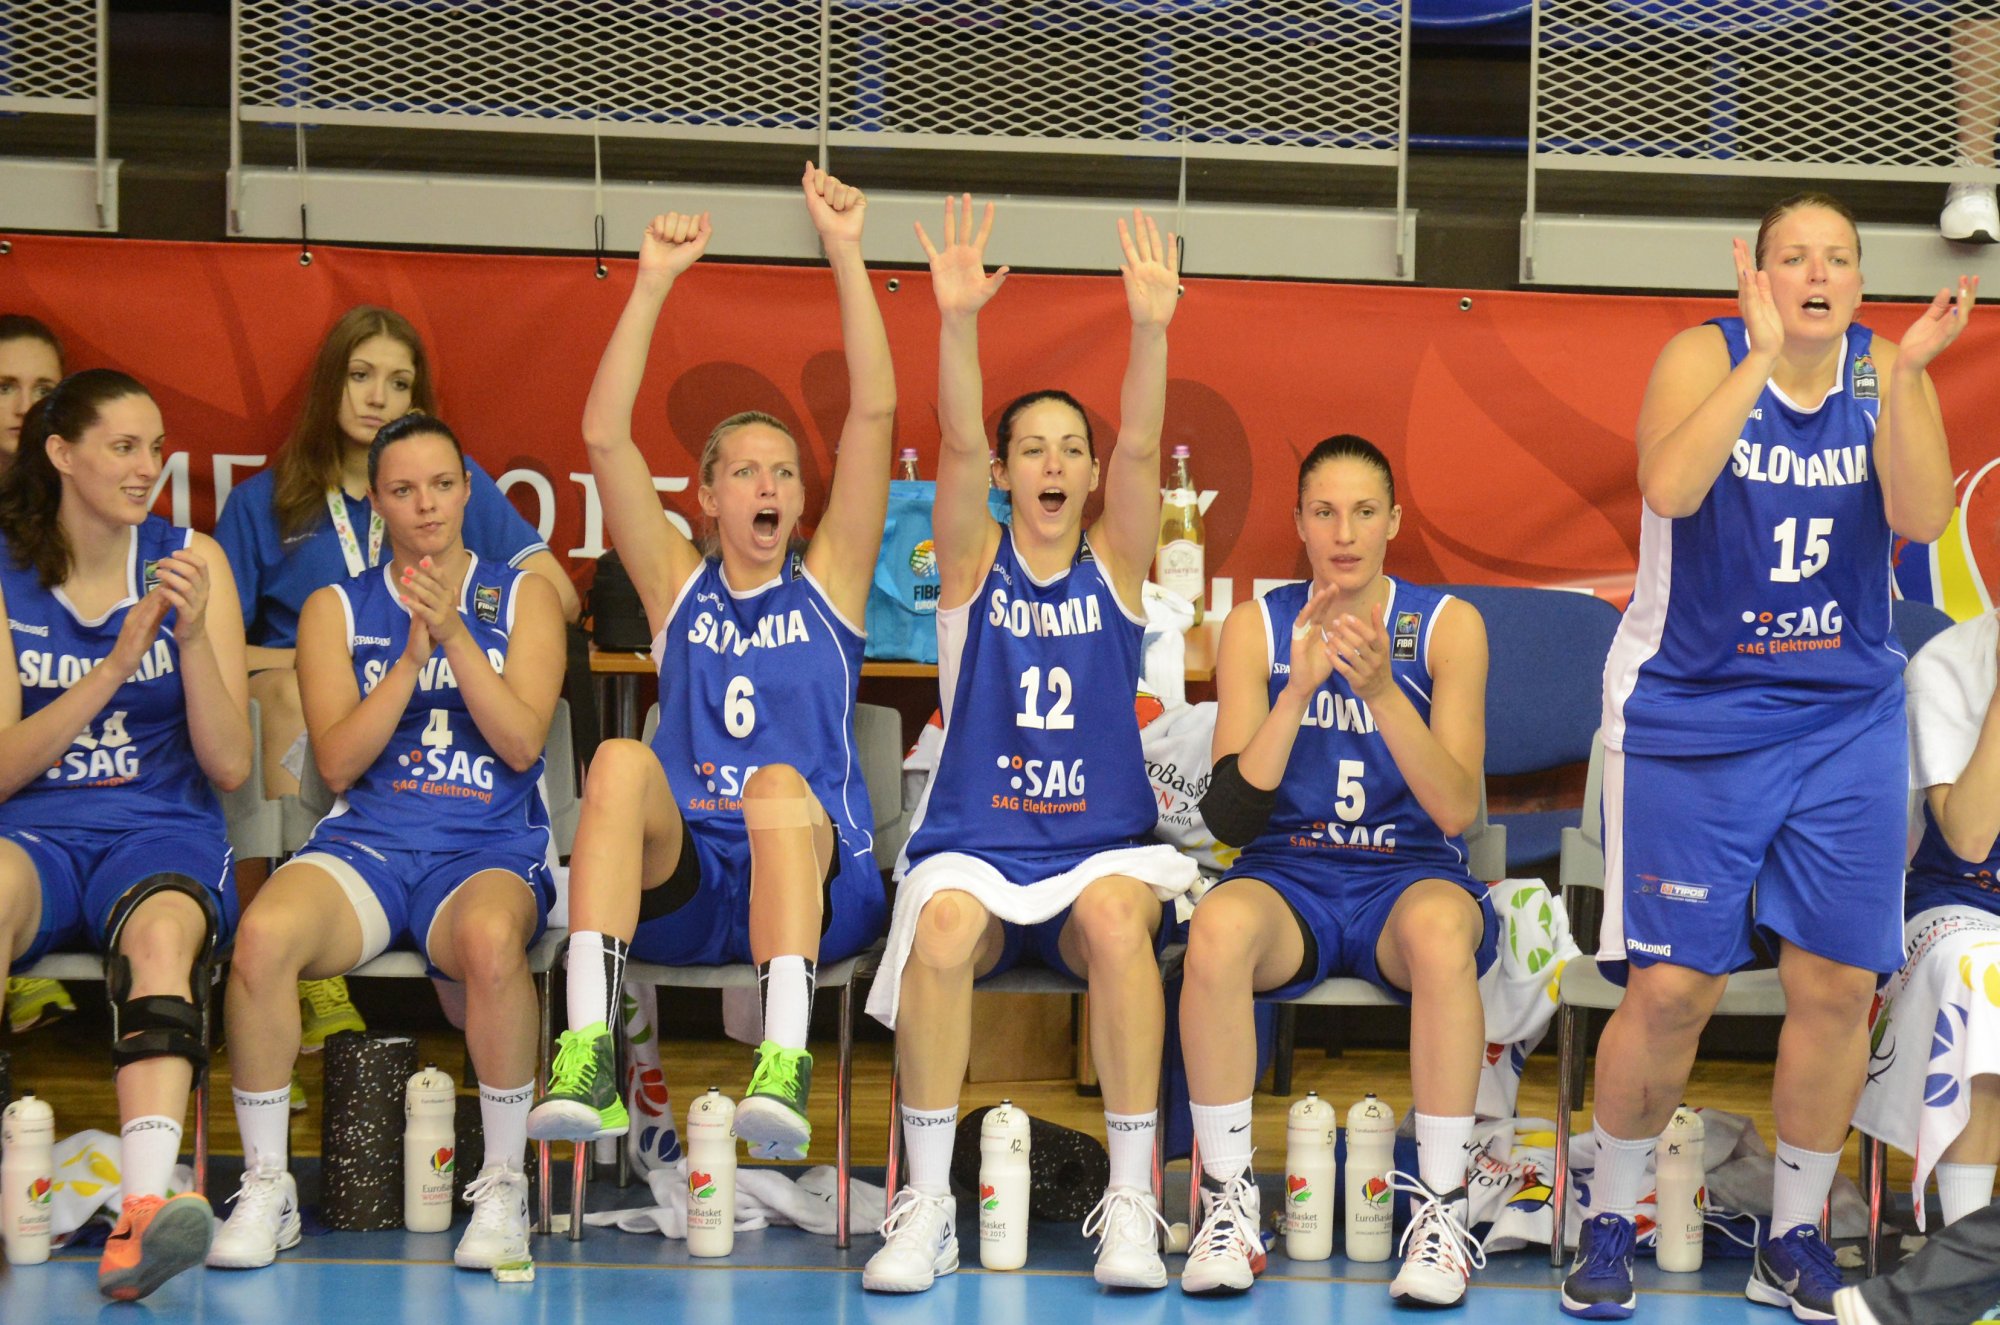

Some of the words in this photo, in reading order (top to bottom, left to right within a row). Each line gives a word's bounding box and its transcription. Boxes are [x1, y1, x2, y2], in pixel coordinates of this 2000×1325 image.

[1732, 438, 1868, 487] SLOVAKIA
[1770, 517, 1834, 583] 15
[1776, 600, 1843, 637] SAG
[1396, 638, 1413, 648] FIBA
[1737, 642, 1765, 655] SAG
[1769, 635, 1841, 653] Elektrovod
[724, 675, 756, 739] 6
[1016, 665, 1075, 730] 12
[421, 708, 453, 750] 4
[64, 746, 140, 781] SAG
[426, 748, 495, 791] SAG
[1025, 759, 1085, 798] SAG
[393, 779, 418, 794] SAG
[421, 782, 492, 804] Elektrovod
[688, 797, 716, 811] SAG
[991, 795, 1019, 811] SAG
[1022, 799, 1087, 814] Elektrovod
[1334, 759, 1366, 822] 5
[1674, 885, 1705, 898] TIPOS
